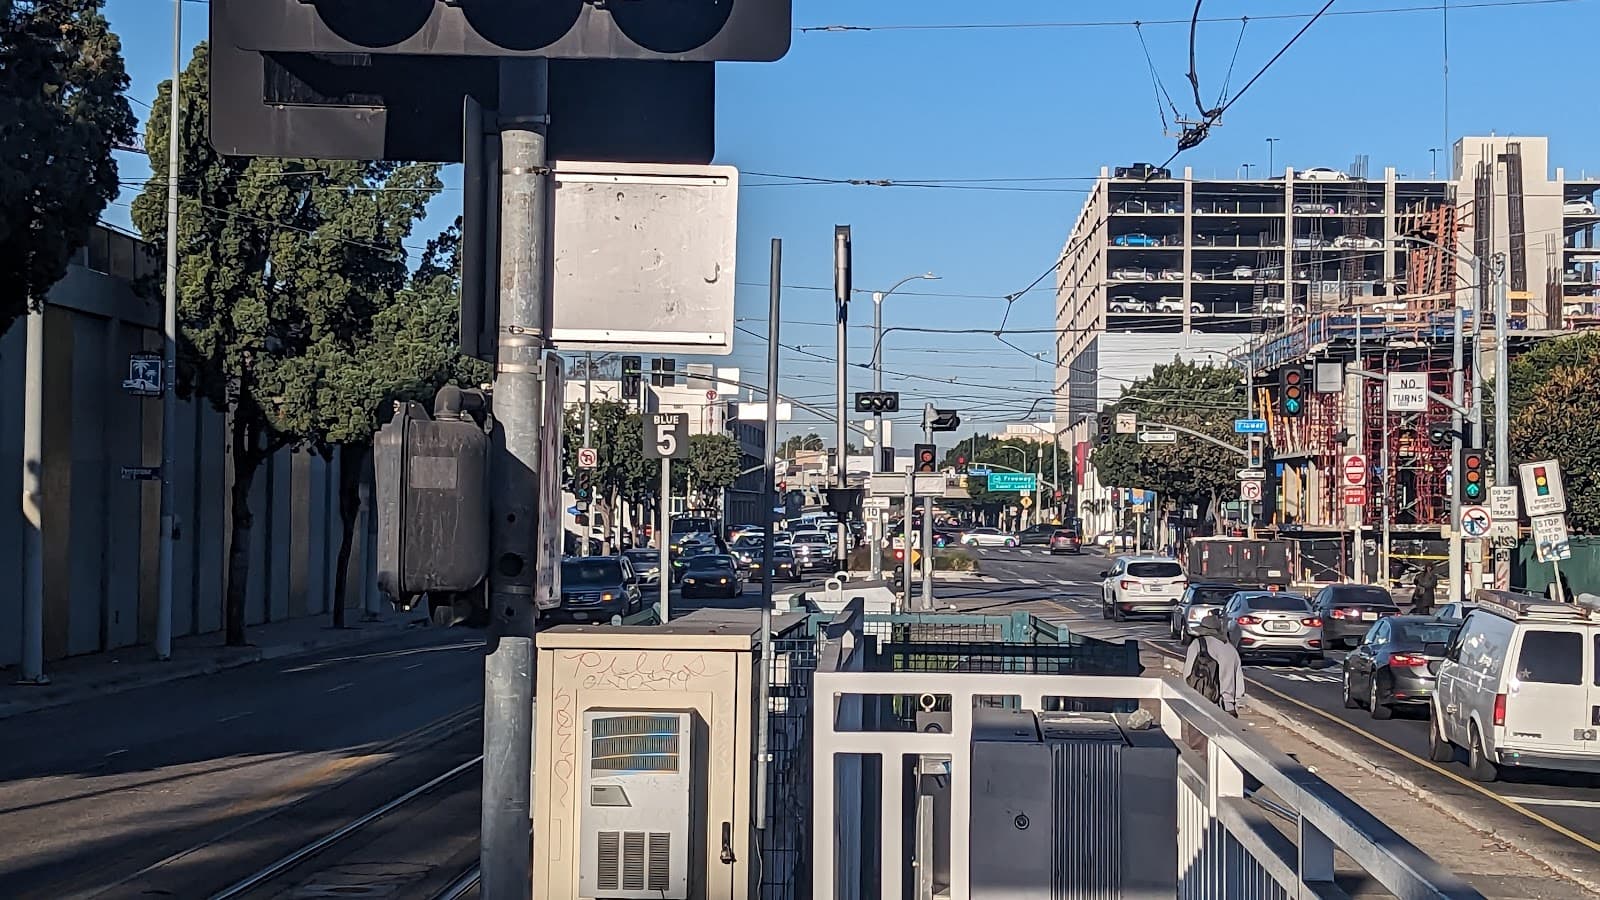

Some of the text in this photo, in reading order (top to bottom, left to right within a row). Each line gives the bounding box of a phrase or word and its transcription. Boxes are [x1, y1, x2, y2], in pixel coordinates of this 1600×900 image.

[1400, 378, 1416, 389] NO
[1393, 394, 1424, 403] TURNS
[653, 415, 679, 425] BLUE
[656, 425, 677, 456] 5
[867, 507, 878, 517] 10
[1530, 502, 1561, 512] ENFORCED
[1537, 518, 1559, 528] STOP
[1543, 533, 1560, 543] RED
